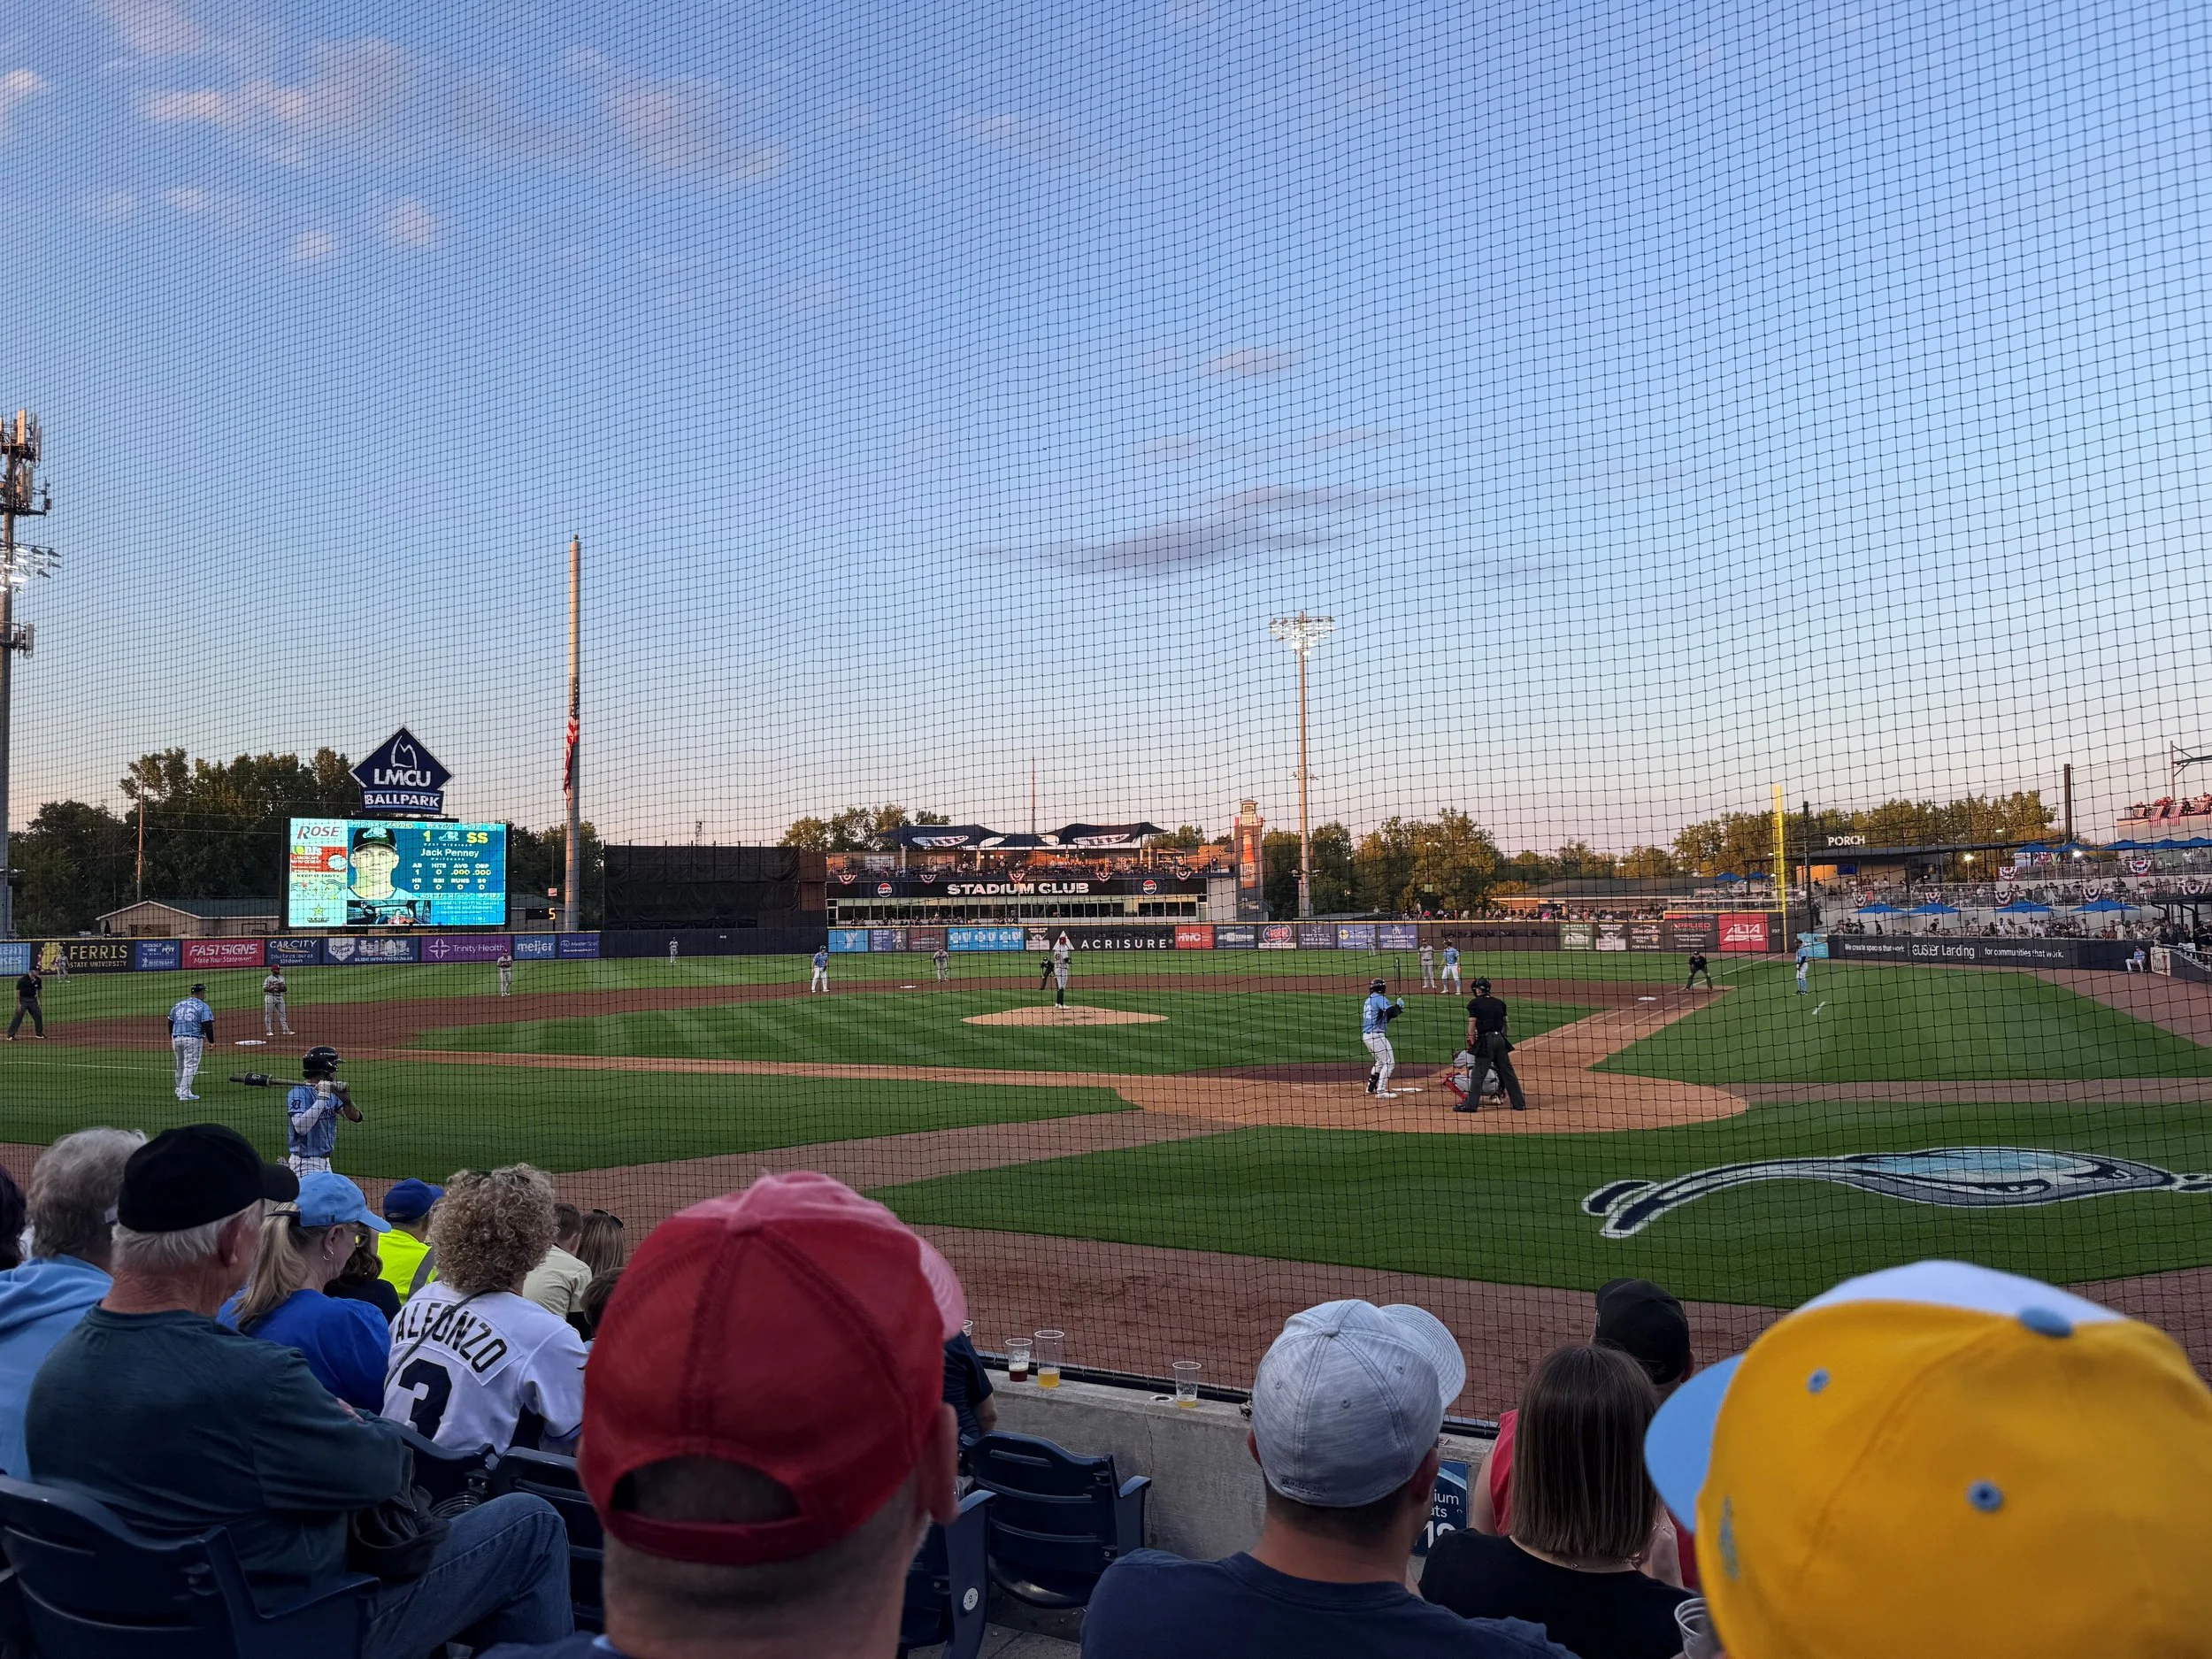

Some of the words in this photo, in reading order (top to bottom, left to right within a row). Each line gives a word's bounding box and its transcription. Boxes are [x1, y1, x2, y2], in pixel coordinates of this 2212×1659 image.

[373, 768, 431, 787] LMCU
[364, 794, 440, 807] BALLPARK
[296, 826, 340, 840] ROSE
[423, 830, 431, 842] 1
[466, 832, 488, 844] SS
[1827, 835, 1866, 846] PORCH
[420, 848, 442, 856] Jack
[445, 849, 480, 858] Penney
[947, 883, 1034, 895] STADIUM
[1038, 882, 1089, 894] CLUB
[549, 907, 556, 920] 5
[1726, 924, 1761, 933] ALTA
[189, 944, 257, 956] FASTSIGNS
[479, 944, 505, 953] Health
[518, 941, 555, 954] meijer
[1081, 940, 1167, 949] ACRISURE
[70, 945, 128, 959] FERRIS
[1941, 945, 1975, 959] Landing
[1993, 949, 2031, 957] communities
[396, 1302, 508, 1373] ALFONZO
